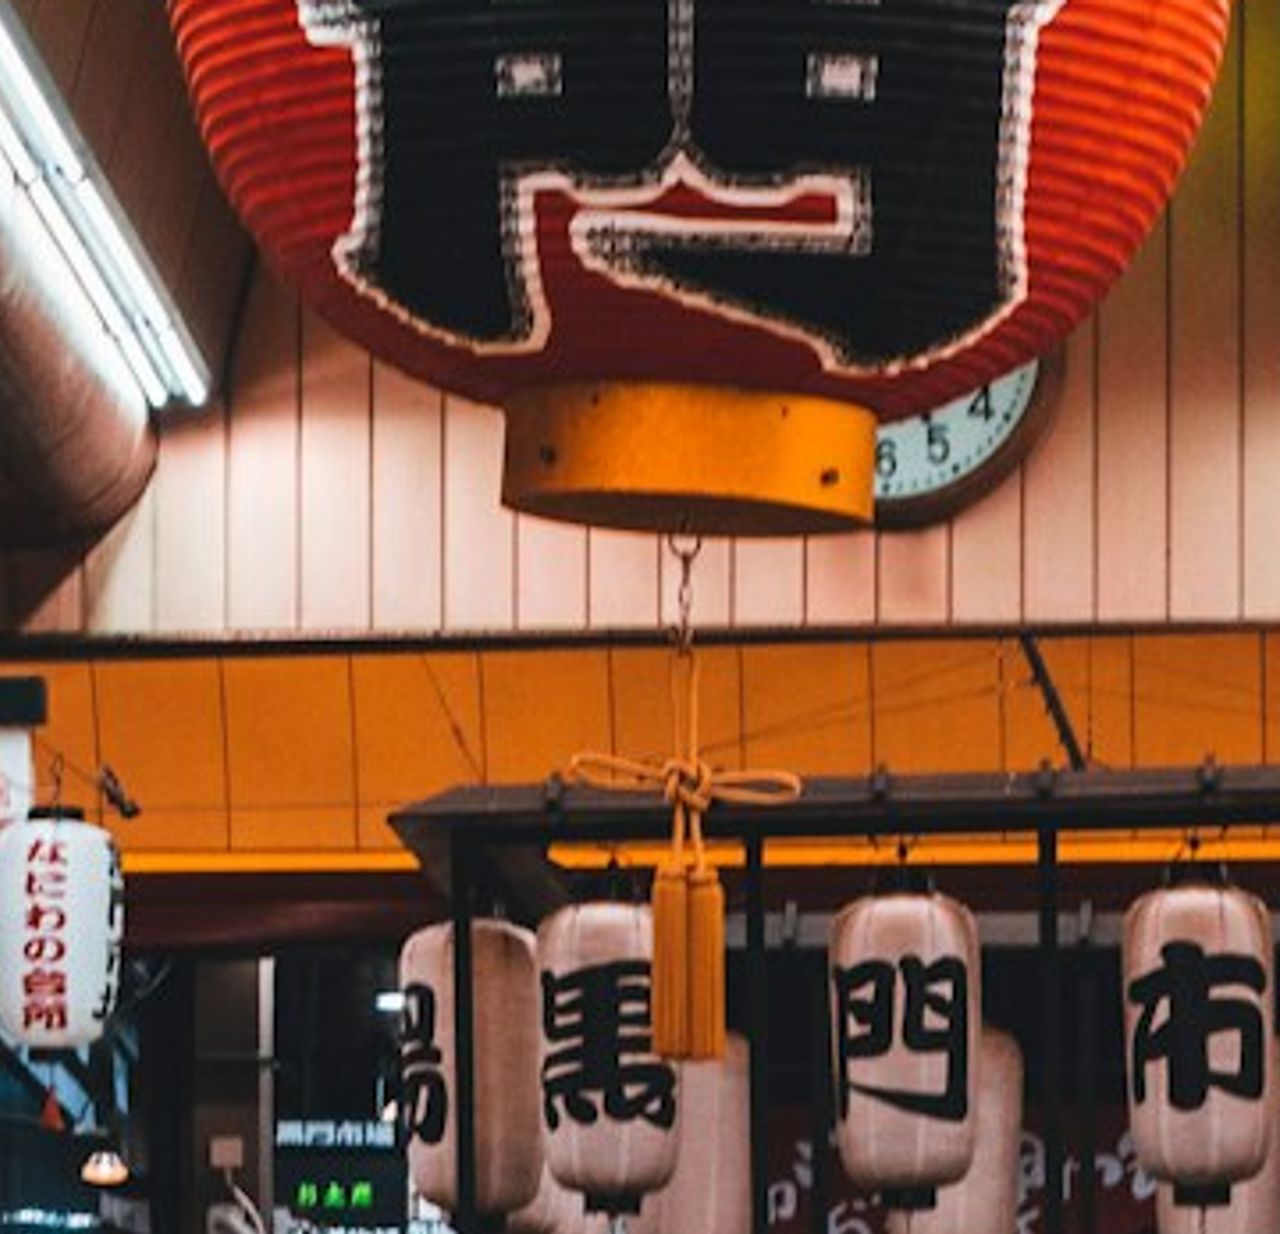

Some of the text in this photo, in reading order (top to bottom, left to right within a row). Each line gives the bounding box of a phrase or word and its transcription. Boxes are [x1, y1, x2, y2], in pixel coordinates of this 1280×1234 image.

[876, 437, 897, 478] 6
[927, 424, 950, 464] 5
[967, 383, 995, 421] 4
[21, 836, 69, 1031] なにわの台所
[542, 960, 676, 1131] 黒
[834, 955, 968, 1122] 門
[1129, 941, 1266, 1112] 市
